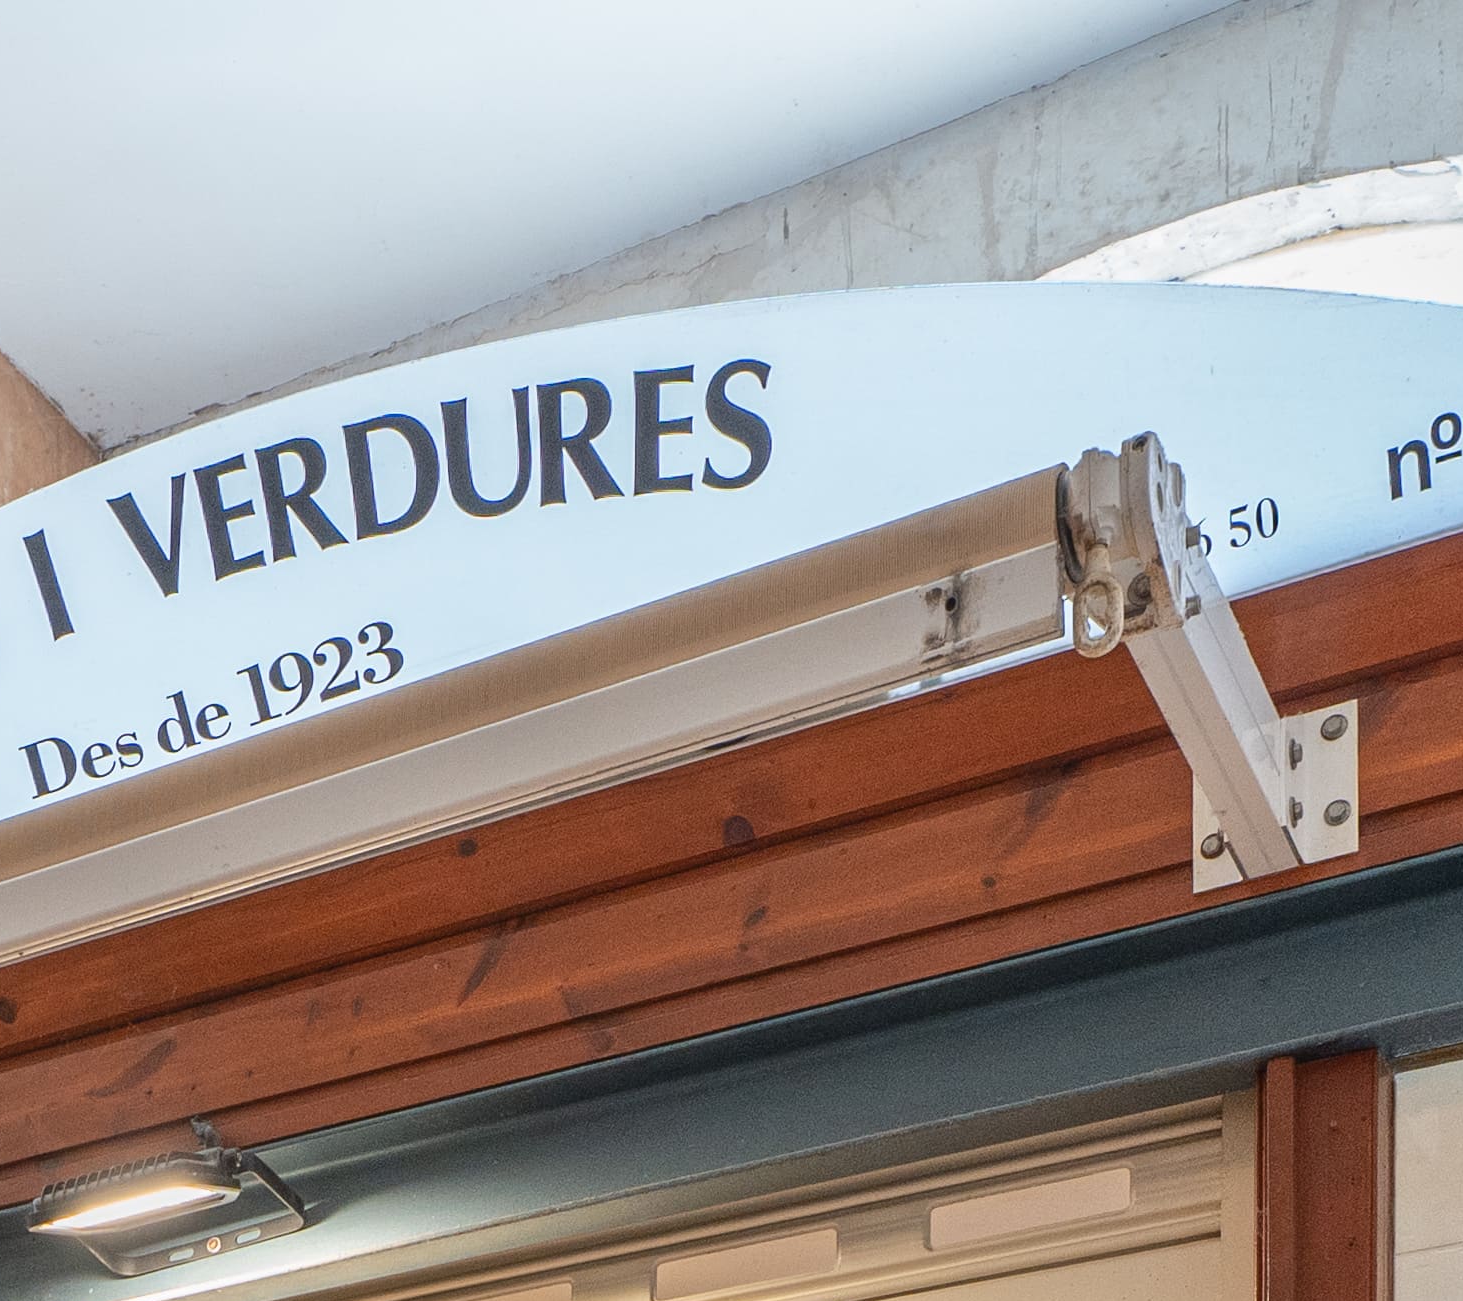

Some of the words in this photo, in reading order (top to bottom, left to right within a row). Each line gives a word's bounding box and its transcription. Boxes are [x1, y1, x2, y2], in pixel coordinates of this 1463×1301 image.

[22, 527, 76, 643] I
[106, 356, 775, 600] VERDURES
[1227, 496, 1280, 549] 50
[17, 734, 146, 802] Des
[156, 689, 236, 757] de
[238, 620, 407, 727] 1923
